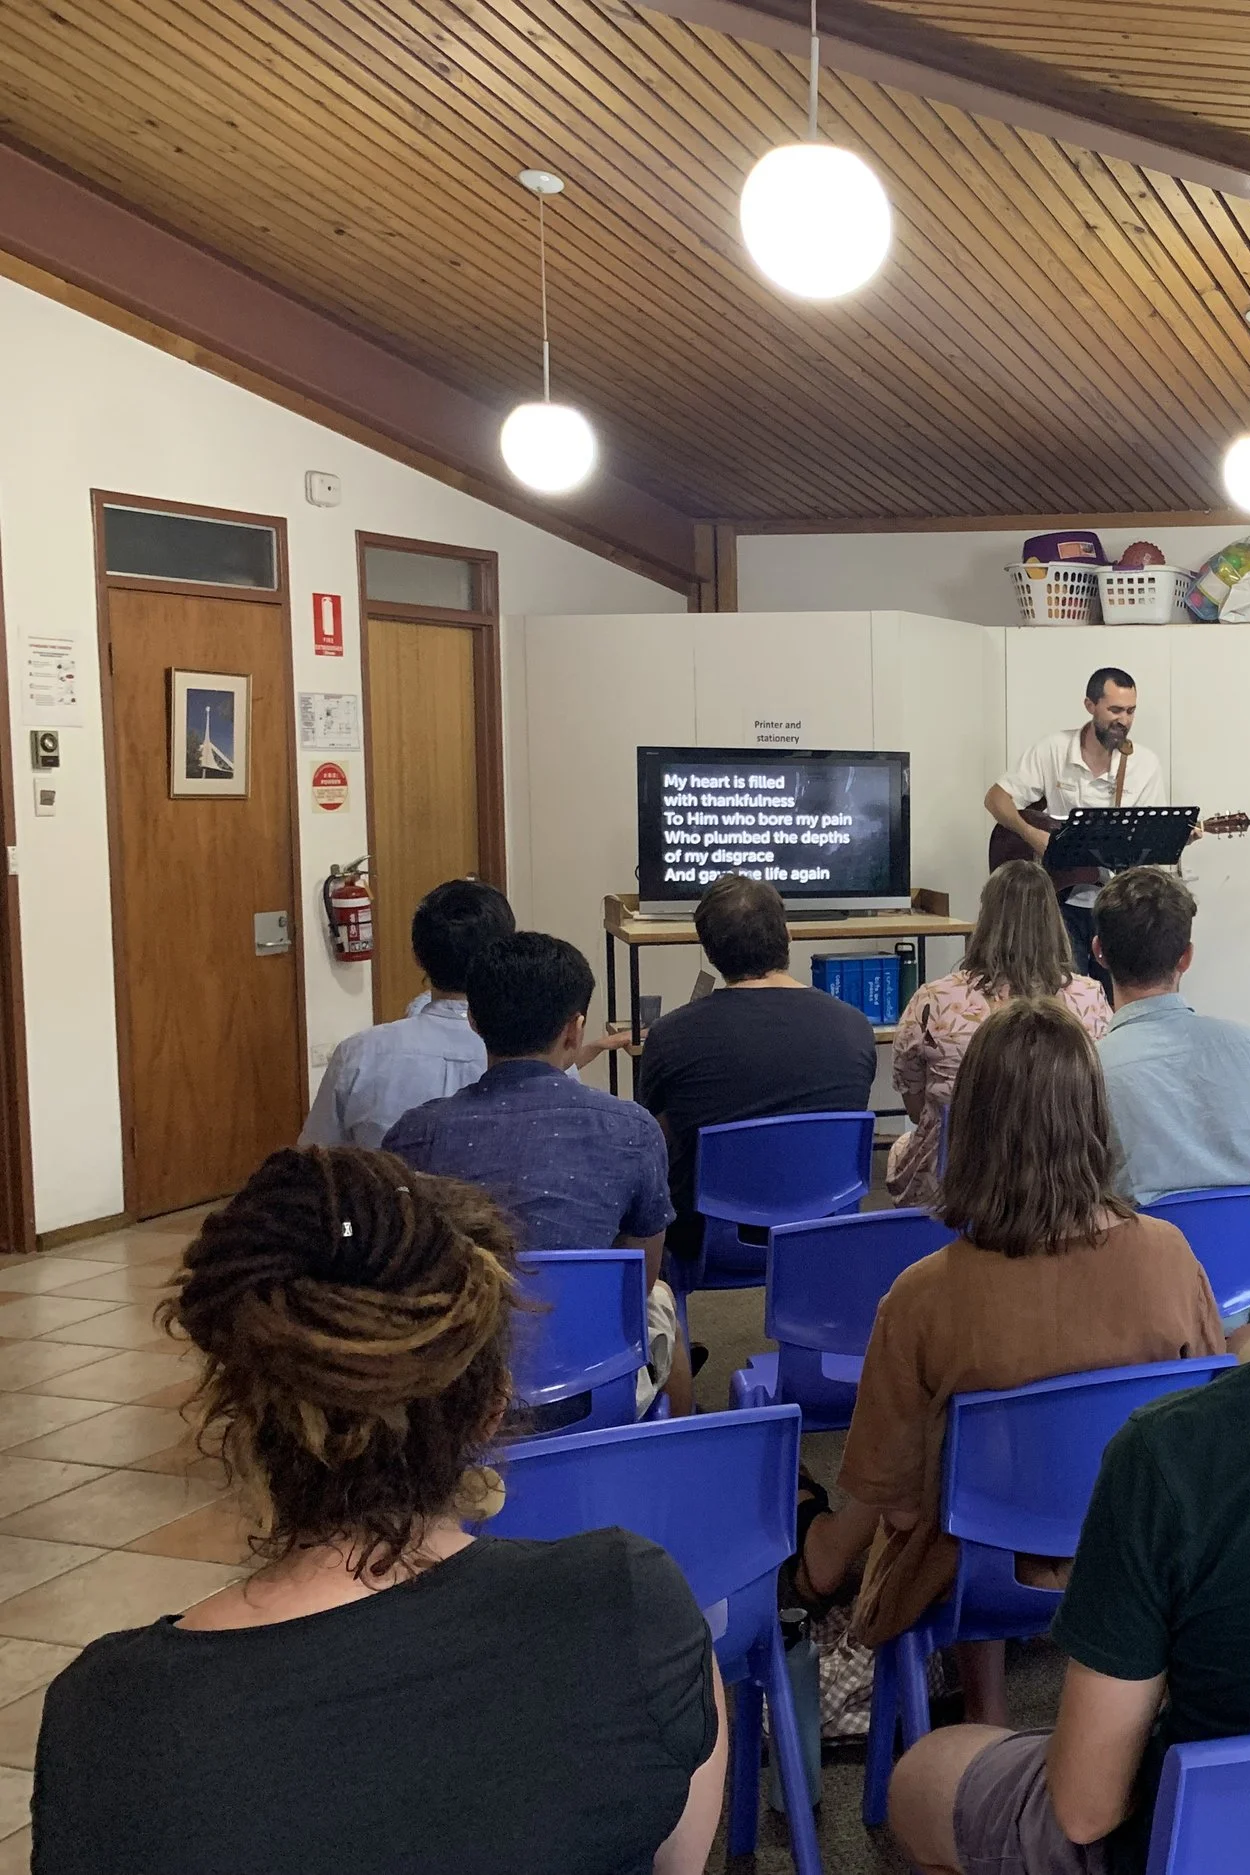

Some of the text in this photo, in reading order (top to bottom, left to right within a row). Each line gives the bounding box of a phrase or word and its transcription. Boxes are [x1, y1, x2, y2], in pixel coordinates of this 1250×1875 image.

[754, 720, 802, 729] Printer and
[756, 733, 800, 745] stationery
[664, 773, 785, 791] My heart is filled
[663, 793, 796, 808] with thankfulness
[663, 811, 853, 829] To Him who bore my pain
[664, 830, 851, 847] Who plumbed the depths
[664, 849, 775, 866] of my disgrace
[664, 867, 696, 882] And
[764, 867, 788, 881] life
[790, 866, 830, 884] again
